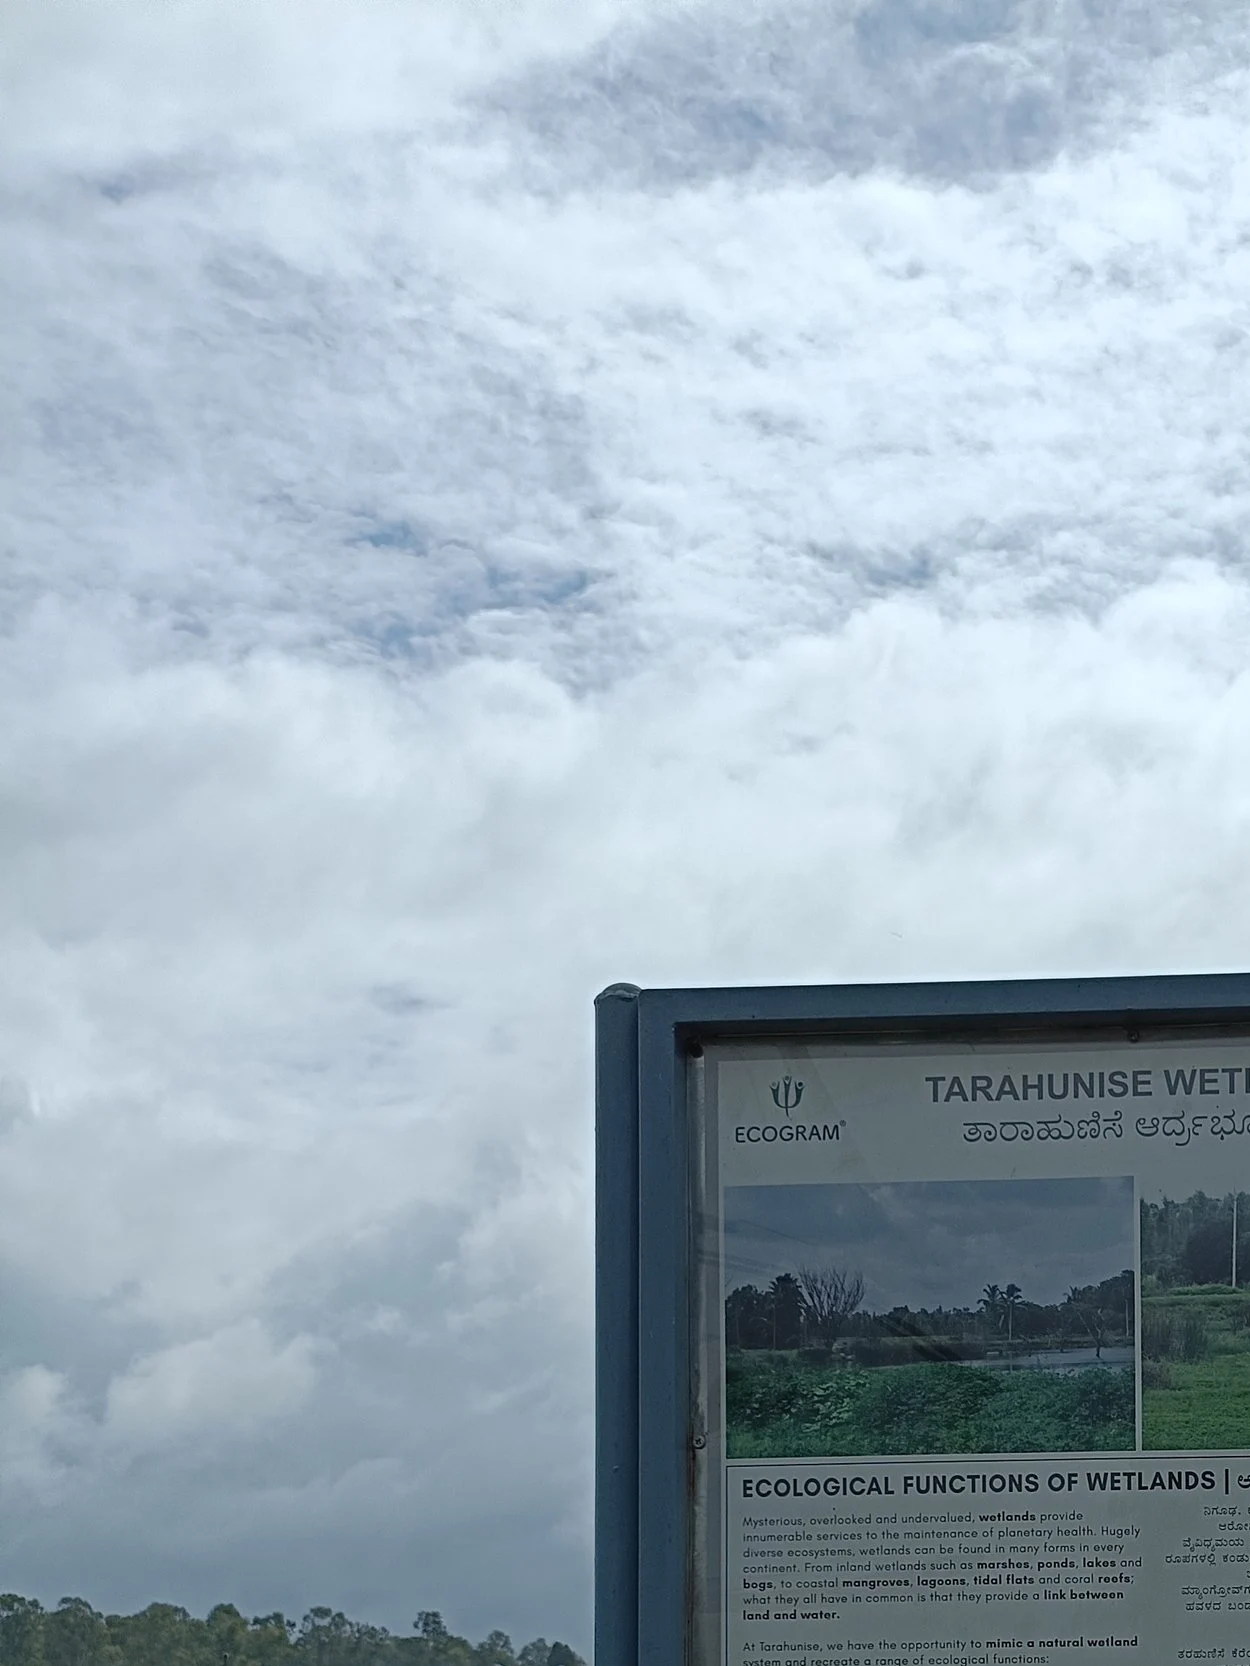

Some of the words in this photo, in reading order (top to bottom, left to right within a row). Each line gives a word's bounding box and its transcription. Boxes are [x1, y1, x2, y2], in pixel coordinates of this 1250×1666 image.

[925, 1070, 1152, 1103] TARAHUNISE
[743, 1477, 894, 1497] ECOLOGICAL
[904, 1474, 1039, 1495] FUNCTIONS
[1048, 1473, 1078, 1491] OF
[1087, 1471, 1215, 1491] WETLANDS
[743, 1517, 805, 1529] Mysterious,
[810, 1513, 871, 1525] overlooked
[876, 1513, 897, 1523] and
[902, 1512, 975, 1523] undervalued,
[979, 1511, 1036, 1522] wetlands
[1040, 1510, 1083, 1526] provide
[744, 1531, 812, 1541] innumerable
[817, 1532, 862, 1540] services
[866, 1531, 877, 1540] to
[881, 1529, 899, 1540] the
[903, 1530, 978, 1539] maintenance
[982, 1527, 994, 1537] of
[998, 1527, 1053, 1543] planetary
[1057, 1526, 1096, 1536] health.
[1102, 1525, 1140, 1538] Hugely
[743, 1547, 783, 1557] diverse
[788, 1548, 855, 1559] ecosystems,
[859, 1545, 910, 1556] wetlands
[940, 1543, 953, 1554] be
[959, 1543, 990, 1553] found
[996, 1545, 1005, 1553] in
[1009, 1546, 1039, 1559] many
[1044, 1542, 1075, 1553] forms
[1080, 1543, 1089, 1551] in
[1094, 1545, 1124, 1558] every
[743, 1565, 799, 1573] continent.
[805, 1563, 832, 1572] From
[837, 1561, 870, 1571] inland
[875, 1560, 926, 1571] wetlands
[931, 1560, 956, 1570] such
[977, 1559, 1033, 1569] marshes,
[1038, 1558, 1078, 1571] ponds,
[1083, 1556, 1116, 1568] lakes
[1120, 1557, 1141, 1567] and
[743, 1579, 776, 1592] bogs,
[781, 1580, 792, 1588] to
[796, 1578, 838, 1588] coastal
[843, 1580, 913, 1589] mangroves,
[918, 1575, 969, 1588] lagoons,
[974, 1574, 1001, 1585] tidal
[1007, 1574, 1034, 1584] flats
[1039, 1573, 1062, 1584] and
[1065, 1573, 1093, 1583] coral
[1099, 1573, 1133, 1584] reefs;
[743, 1595, 770, 1605] what
[775, 1594, 799, 1607] they
[803, 1594, 816, 1603] all
[821, 1594, 847, 1604] have
[852, 1594, 861, 1602] in
[918, 1593, 926, 1601] is
[930, 1591, 952, 1601] that
[958, 1591, 981, 1604] they
[986, 1590, 1028, 1603] provide
[1044, 1589, 1066, 1600] link
[1070, 1589, 1123, 1599] between
[743, 1610, 769, 1620] land
[774, 1609, 796, 1619] and
[801, 1611, 839, 1619] water.
[743, 1643, 754, 1651] At
[760, 1641, 822, 1652] Tarahunise,
[848, 1641, 874, 1650] have
[879, 1640, 896, 1649] the
[901, 1640, 966, 1652] opportunity
[971, 1640, 981, 1648] to
[986, 1639, 1022, 1648] mimic
[1039, 1637, 1083, 1647] natural
[1087, 1636, 1137, 1647] wetland
[785, 1656, 806, 1666] and
[811, 1658, 860, 1666] recreate
[913, 1655, 924, 1665] of
[929, 1654, 988, 1666] ecological
[994, 1654, 1048, 1664] functions:
